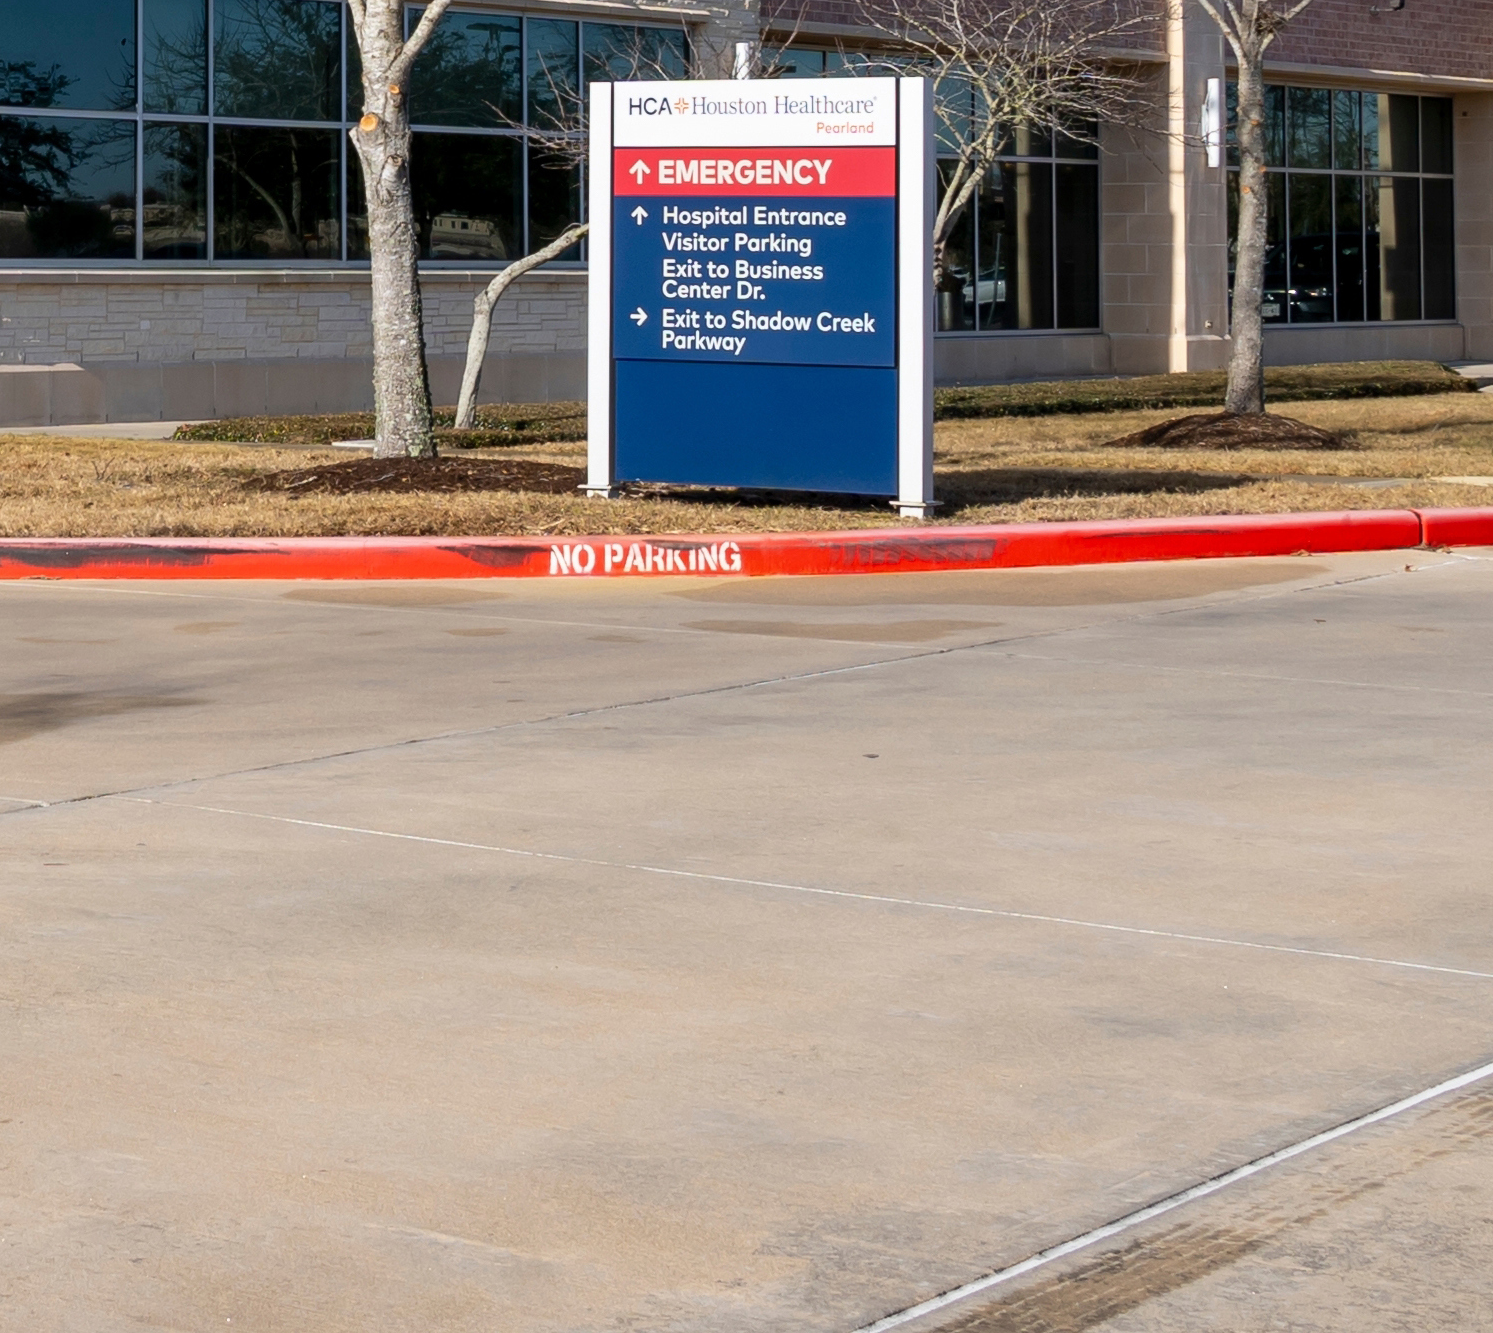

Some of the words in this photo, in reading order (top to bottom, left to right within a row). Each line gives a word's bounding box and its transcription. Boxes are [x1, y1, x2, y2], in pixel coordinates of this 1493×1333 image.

[629, 97, 672, 115] HCA
[692, 96, 767, 115] Houston
[774, 95, 874, 114] Healthcare
[816, 121, 874, 134] Pearland
[658, 159, 832, 184] EMERGENCY
[663, 206, 747, 229] Hospital
[754, 207, 846, 226] Entrance
[662, 232, 728, 251] Visitor
[735, 233, 812, 258] Parking
[662, 259, 702, 278] Exit
[706, 263, 729, 279] to
[735, 260, 823, 280] Business
[662, 280, 731, 299] Center
[737, 281, 766, 300] Dr.
[662, 309, 701, 328] Exit
[705, 313, 727, 329] to
[732, 311, 811, 331] Shadow
[816, 312, 875, 333] Creek
[662, 331, 746, 355] Parkway
[549, 543, 596, 575] NO
[604, 541, 742, 573] PARKING
